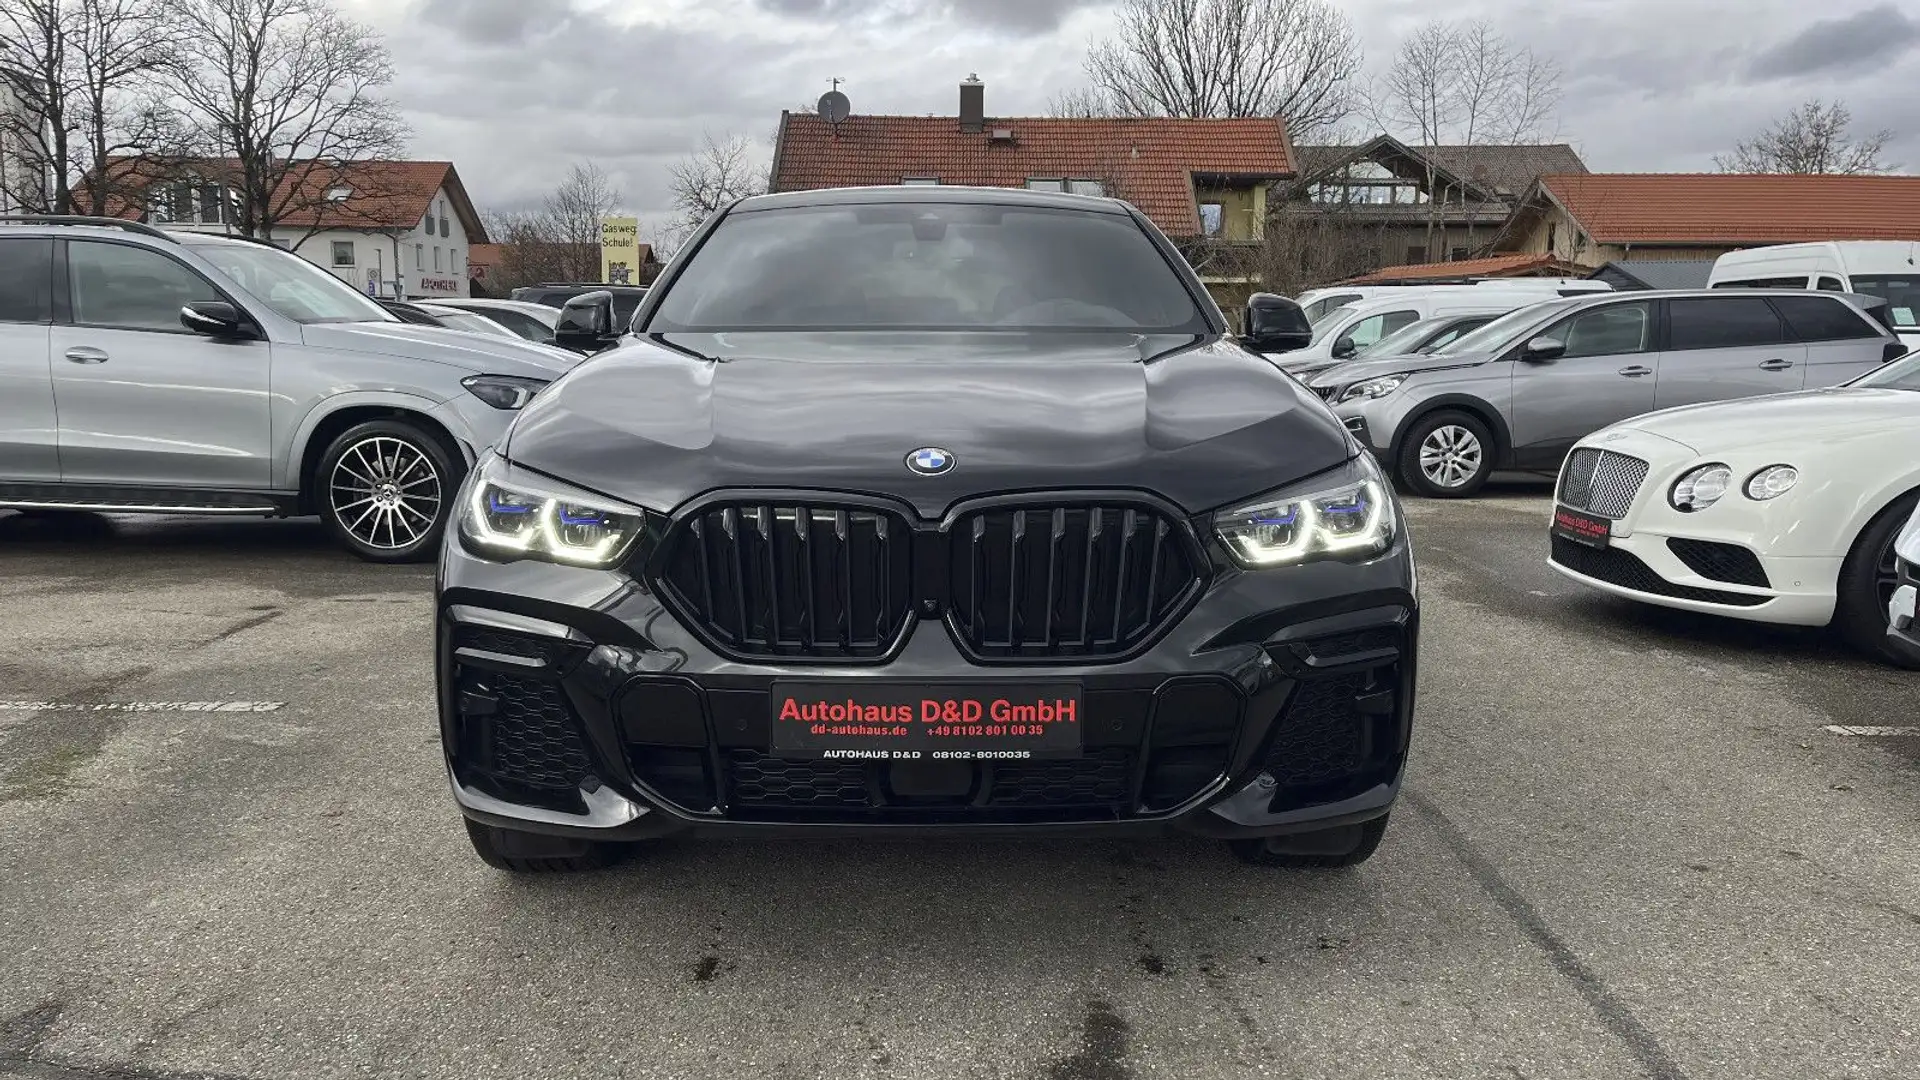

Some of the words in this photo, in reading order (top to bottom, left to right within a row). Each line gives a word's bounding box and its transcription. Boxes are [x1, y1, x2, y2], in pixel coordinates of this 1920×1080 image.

[779, 698, 912, 722] Autohaus
[921, 699, 982, 722] D&D
[990, 699, 1076, 722] GmbH
[810, 724, 908, 736] dd-autohaus.de
[927, 725, 950, 736] +49
[953, 725, 983, 736] 8102
[985, 725, 1007, 736] 801
[1010, 725, 1026, 735] 00
[1028, 725, 1043, 735] 35
[823, 750, 889, 759] AUTOHAUS
[893, 751, 921, 759] D&D
[932, 751, 1031, 759] 08102-8010035
